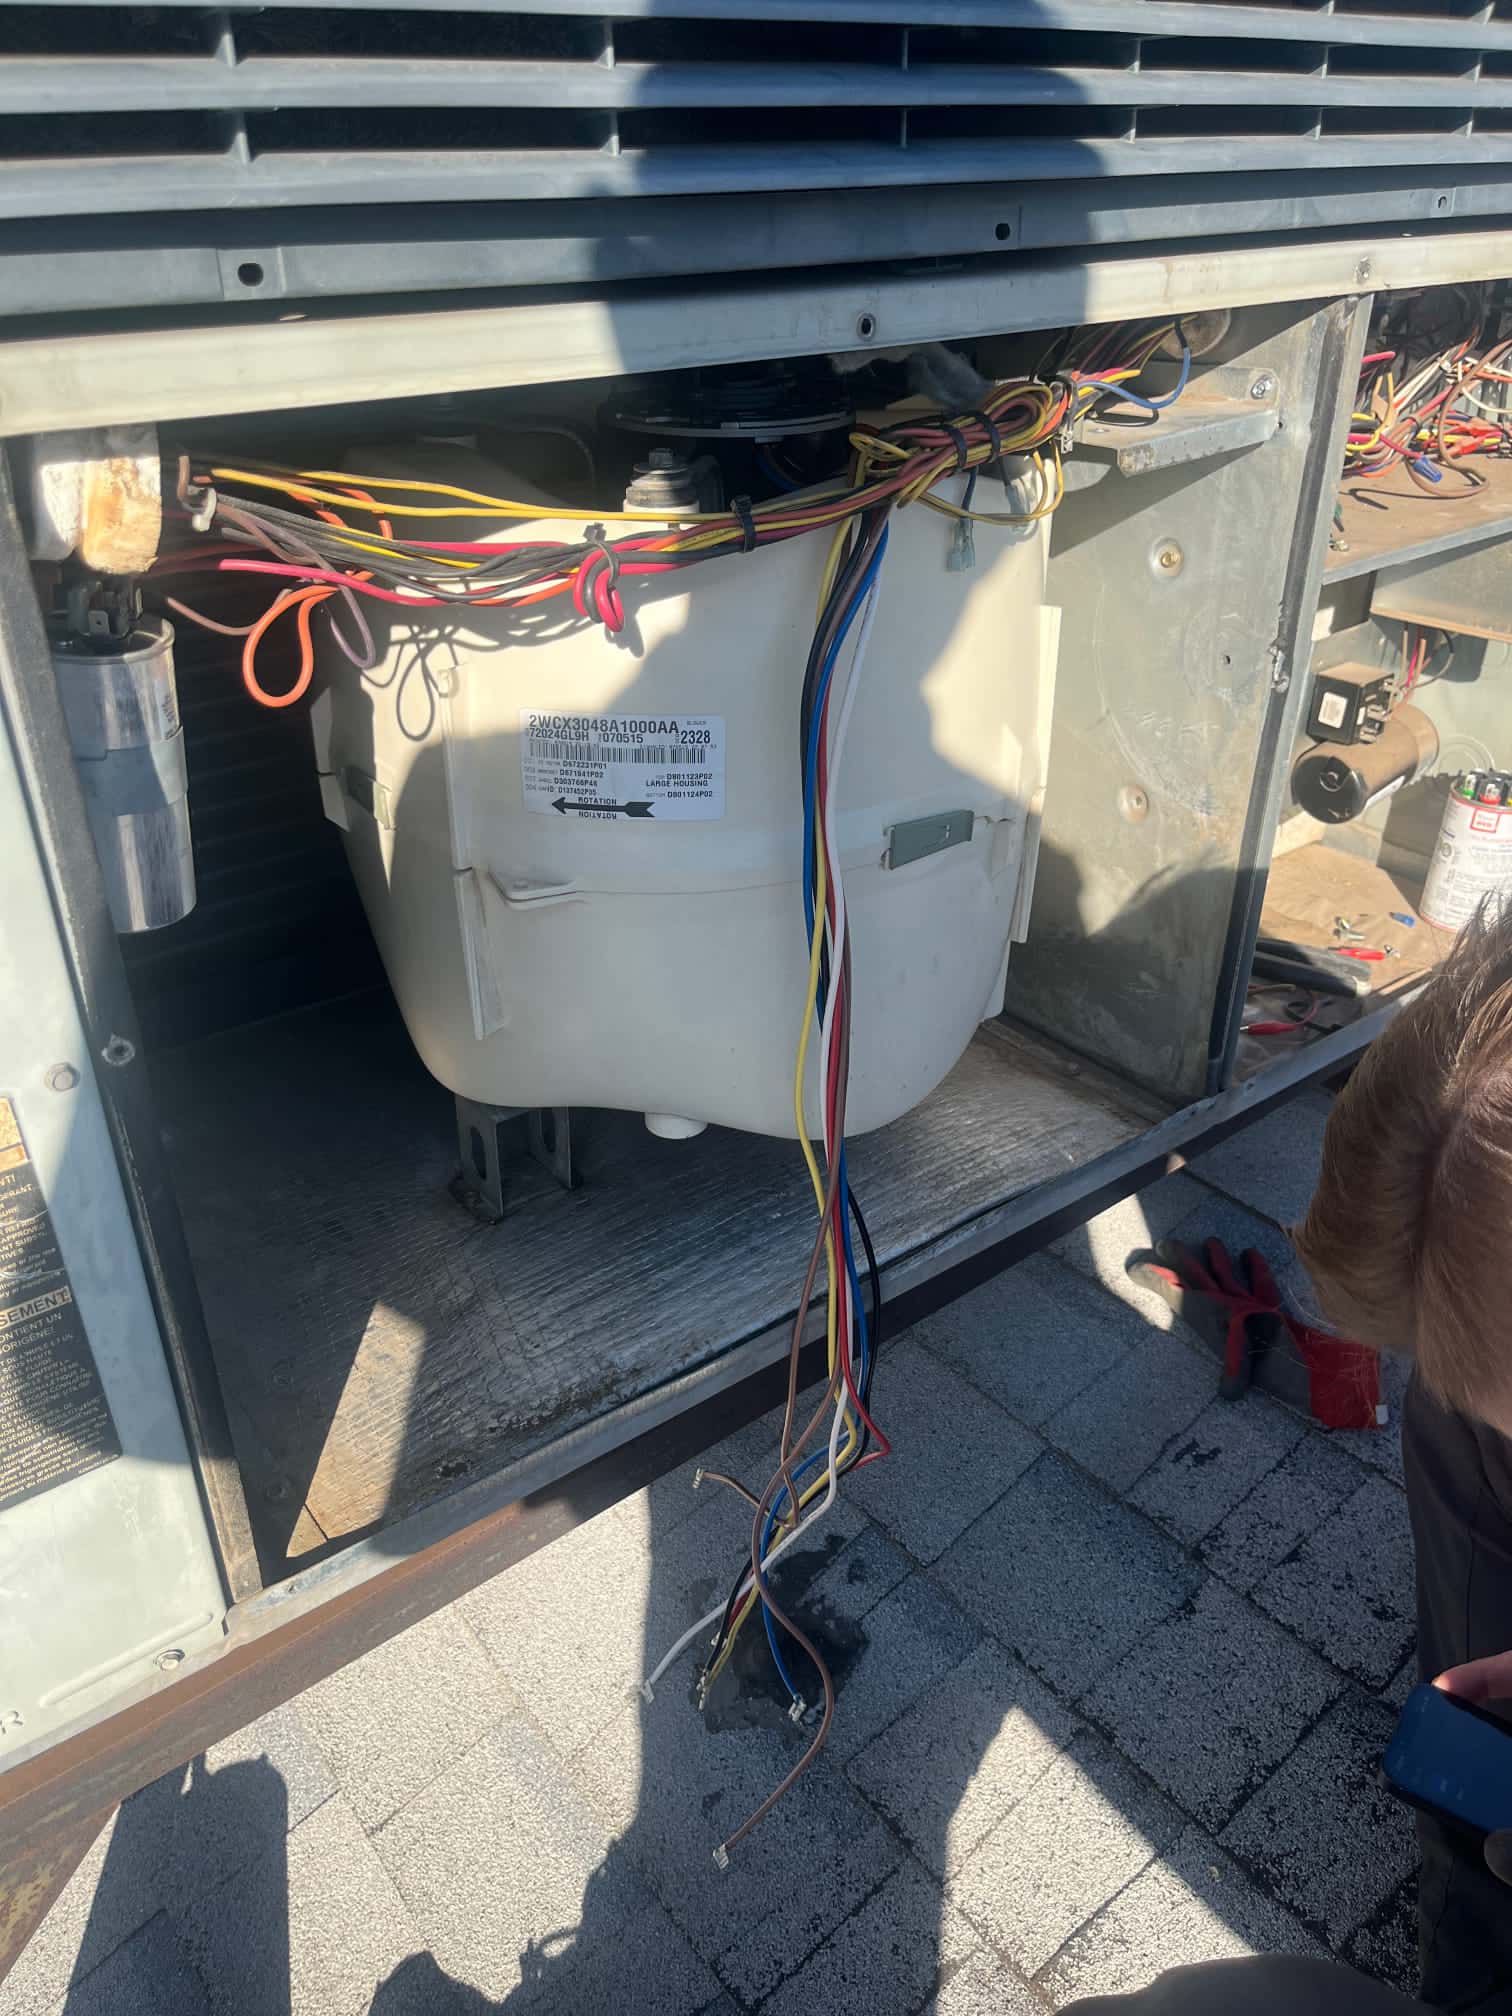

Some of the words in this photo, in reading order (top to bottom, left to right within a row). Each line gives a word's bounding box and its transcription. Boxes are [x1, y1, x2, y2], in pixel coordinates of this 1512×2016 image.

[529, 714, 679, 734] 2WCX3048A1000AA
[603, 733, 644, 743] 070515
[680, 730, 711, 744] 2328
[577, 797, 617, 806] ROTATION
[578, 811, 617, 820] ROTATION
